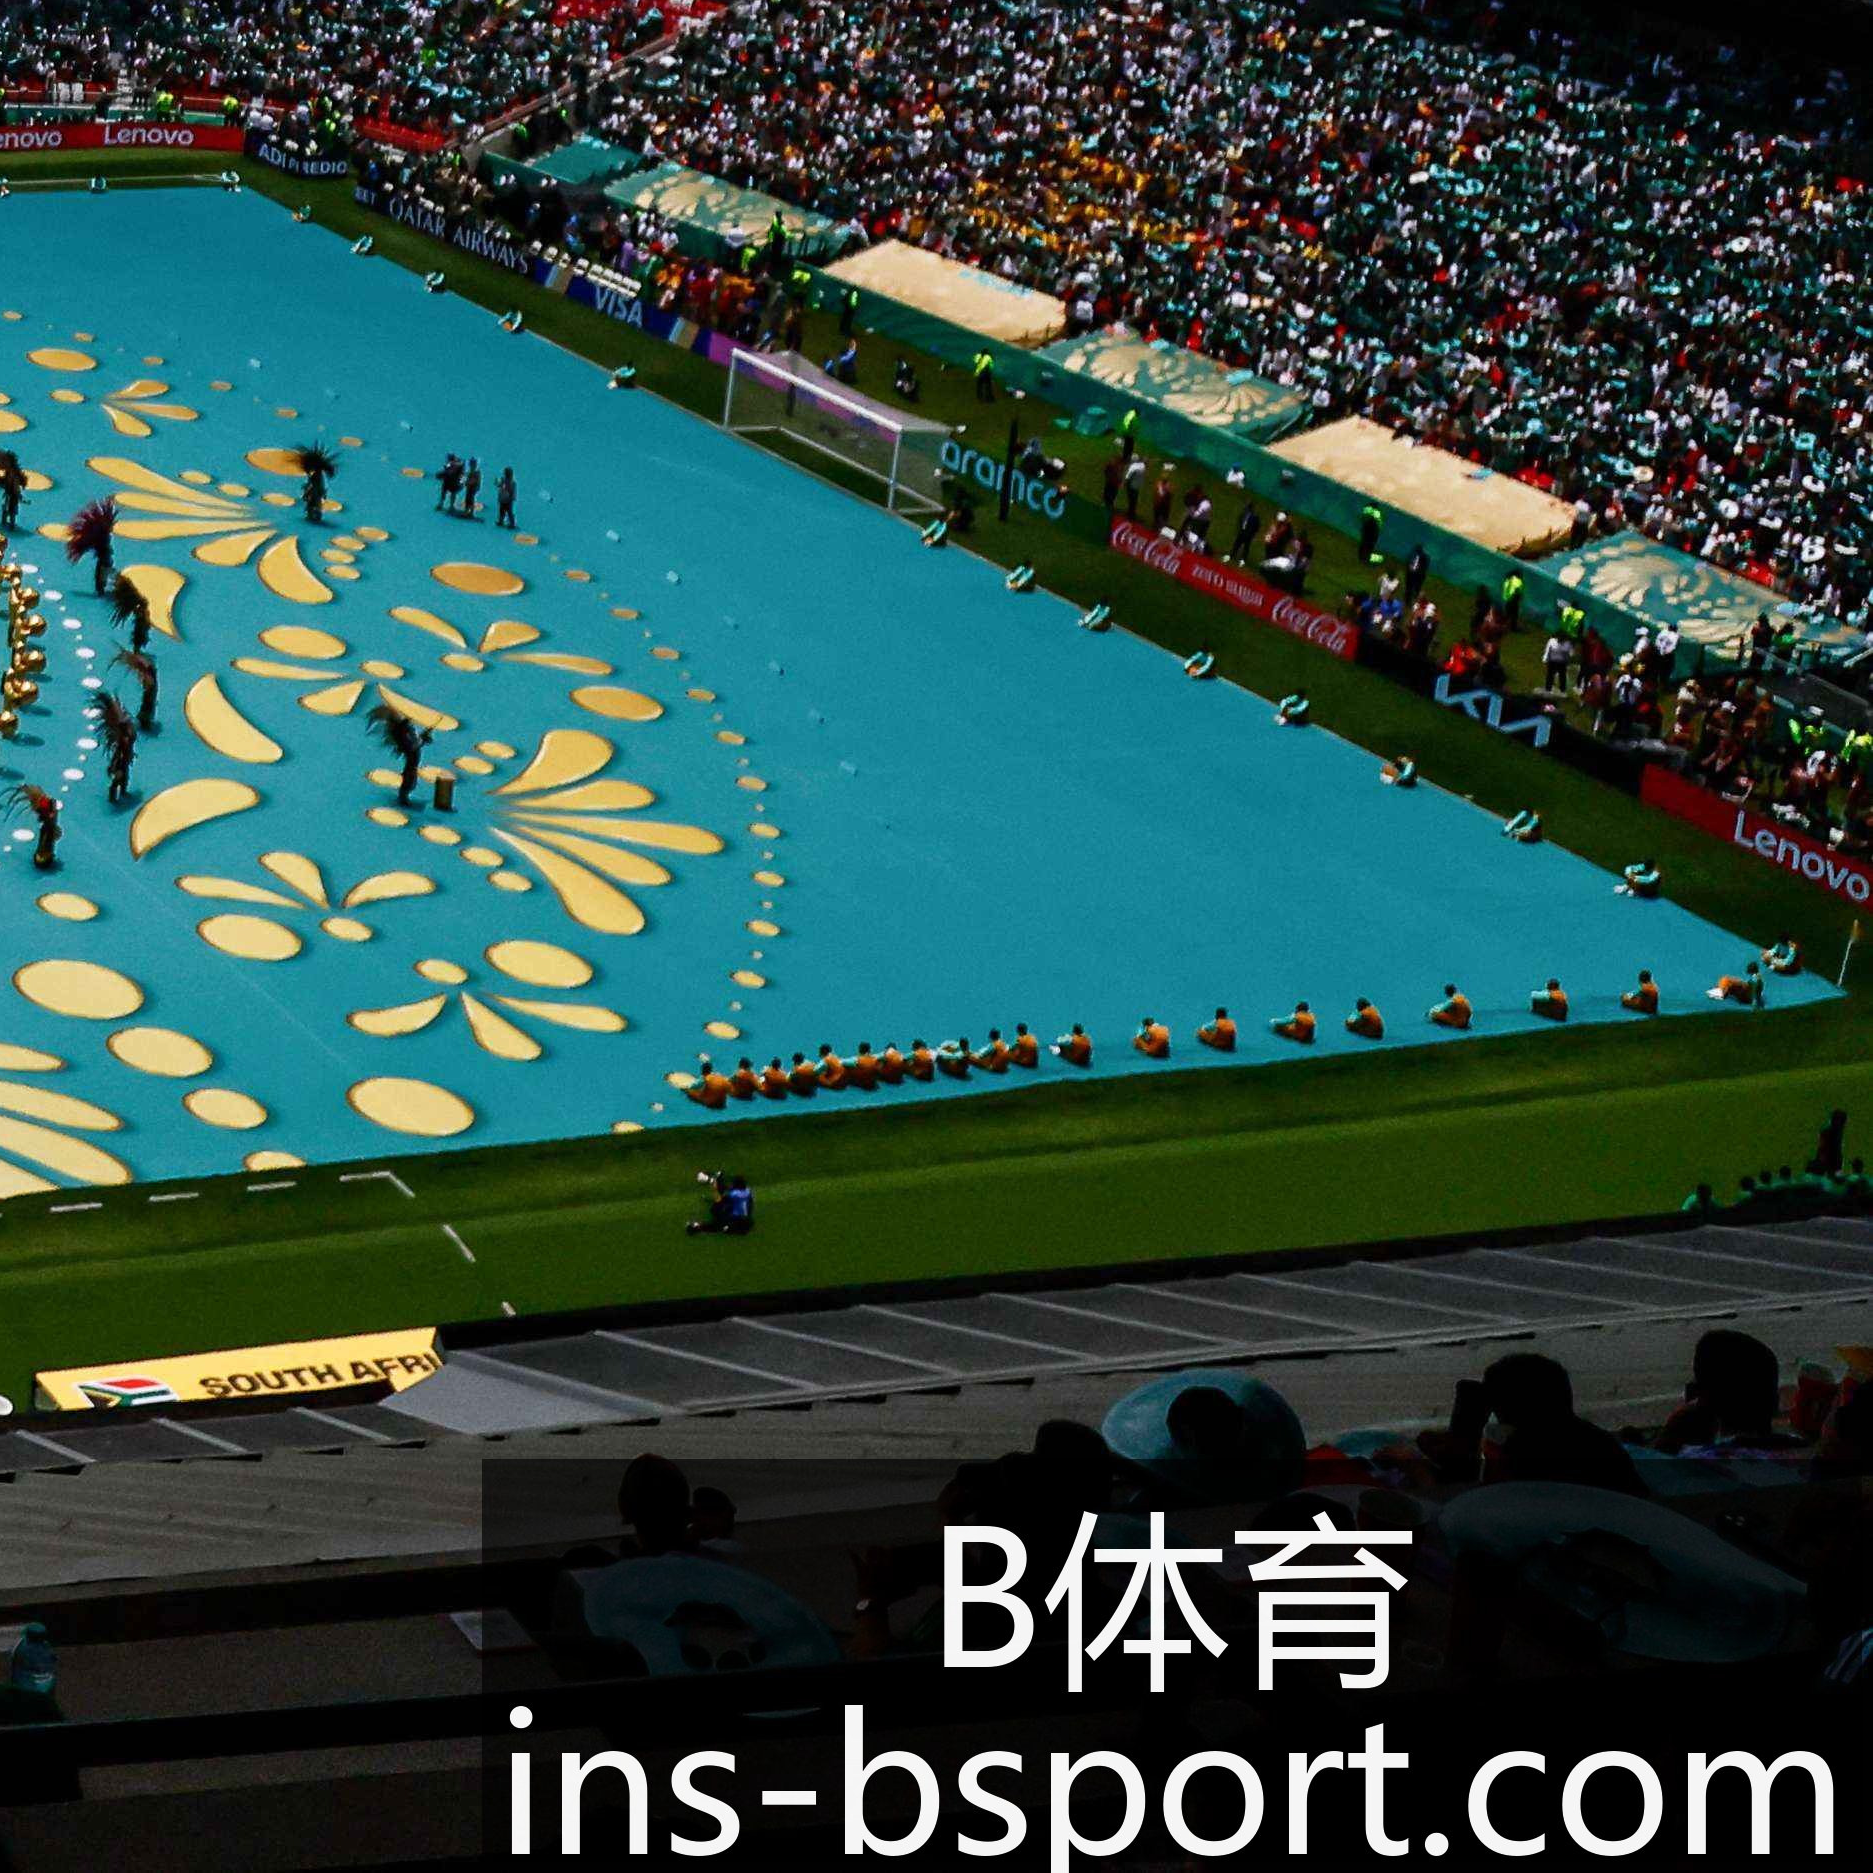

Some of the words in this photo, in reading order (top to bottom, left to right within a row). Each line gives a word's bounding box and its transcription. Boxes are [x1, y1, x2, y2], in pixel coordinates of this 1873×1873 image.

[104, 124, 194, 146] Lenovo
[259, 143, 286, 168] ADI
[388, 193, 446, 238] QATAR
[453, 225, 530, 276] AIRWAYS
[594, 283, 643, 328] VISA
[941, 439, 1065, 519] aramco
[1734, 810, 1870, 903] Lenovo
[199, 1363, 344, 1398] SOUTH
